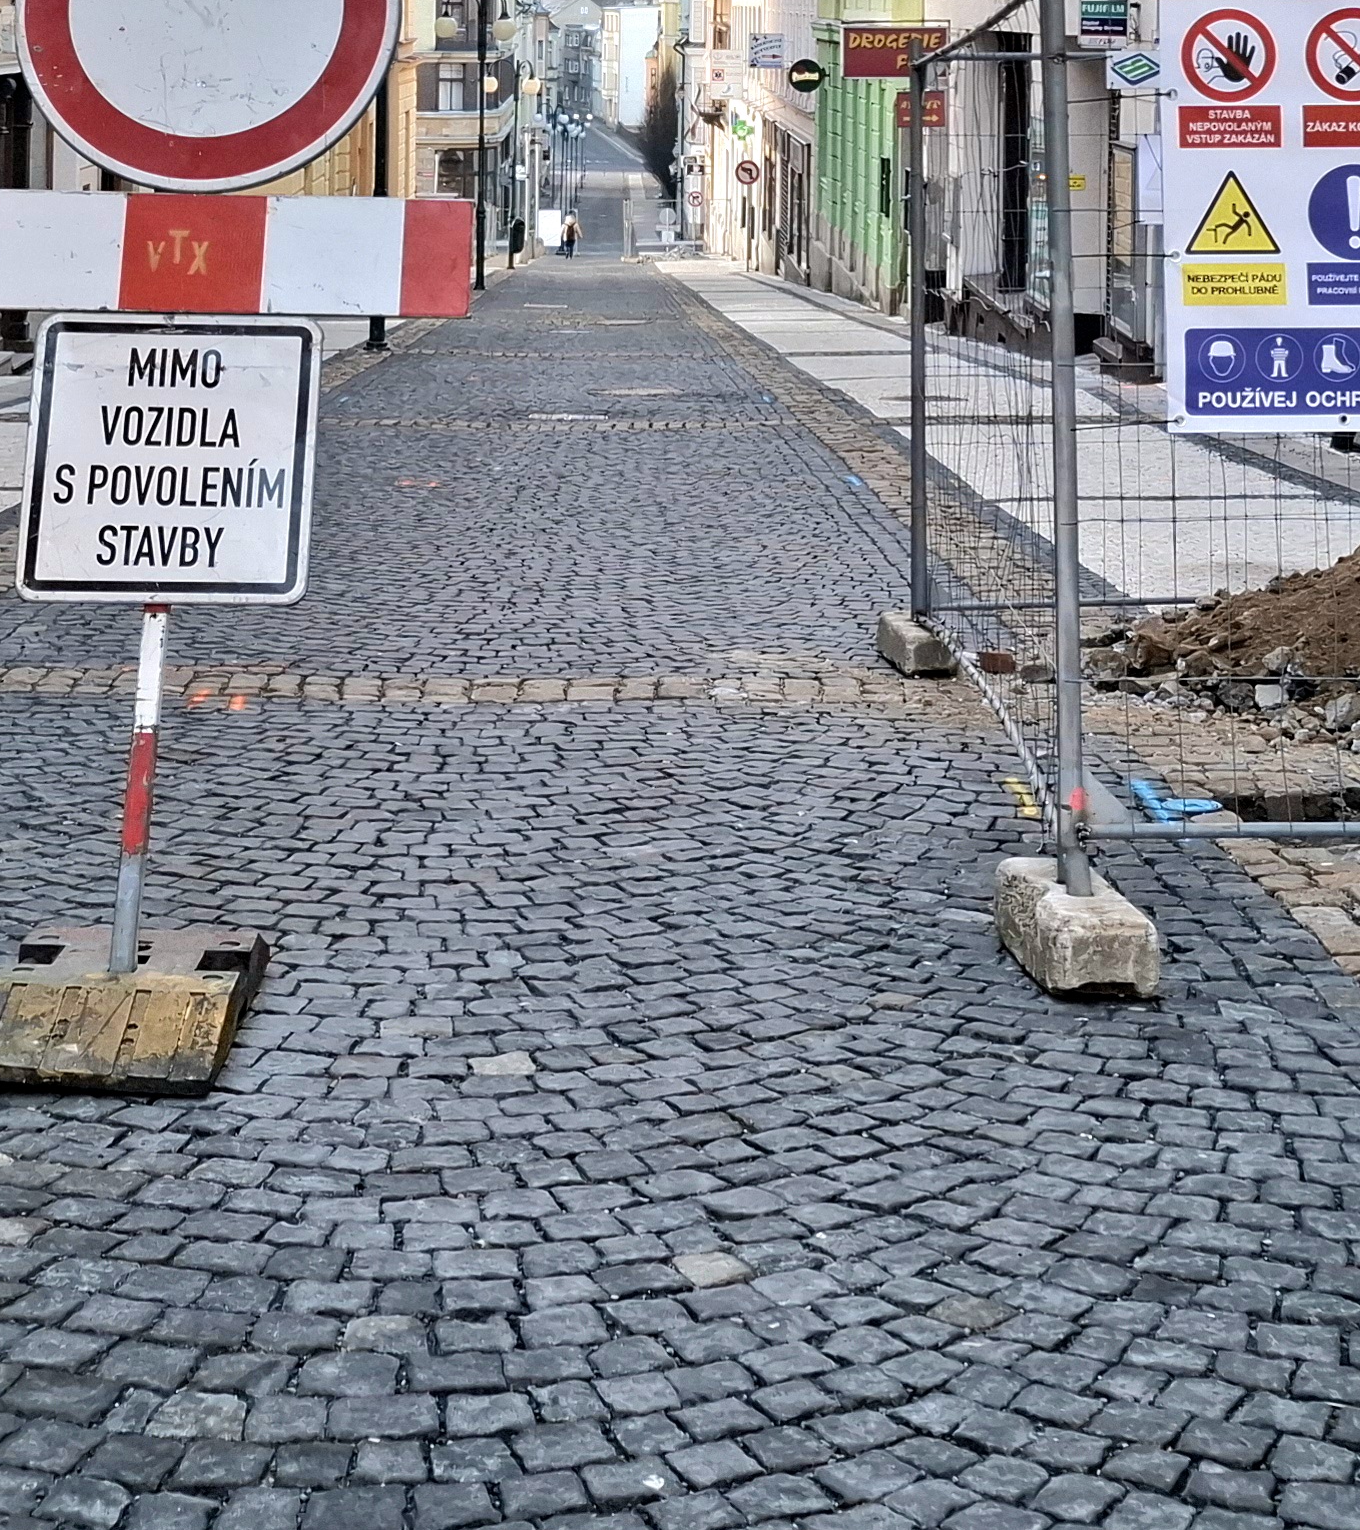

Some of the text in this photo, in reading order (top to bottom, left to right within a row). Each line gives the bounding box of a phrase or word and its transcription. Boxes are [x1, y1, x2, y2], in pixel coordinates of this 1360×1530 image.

[1081, 4, 1125, 14] FUJIFLM
[1208, 109, 1251, 119] STAVBA
[1189, 121, 1272, 131] NEPOVOLANÝM
[1306, 120, 1346, 132] ZÁKAZ
[1186, 132, 1275, 144] VSTUP ZAKÁZÁN
[1187, 271, 1282, 283] NEBEZPEČÍ PÁDU
[1191, 285, 1279, 296] DO PROHLUBNĚ
[127, 347, 223, 389] MIMO
[1198, 387, 1298, 409] POUŽÍVEJ
[101, 405, 241, 449] VOZIDLA
[53, 459, 286, 509] S POVOLENÍM
[96, 524, 225, 569] STAVBY
